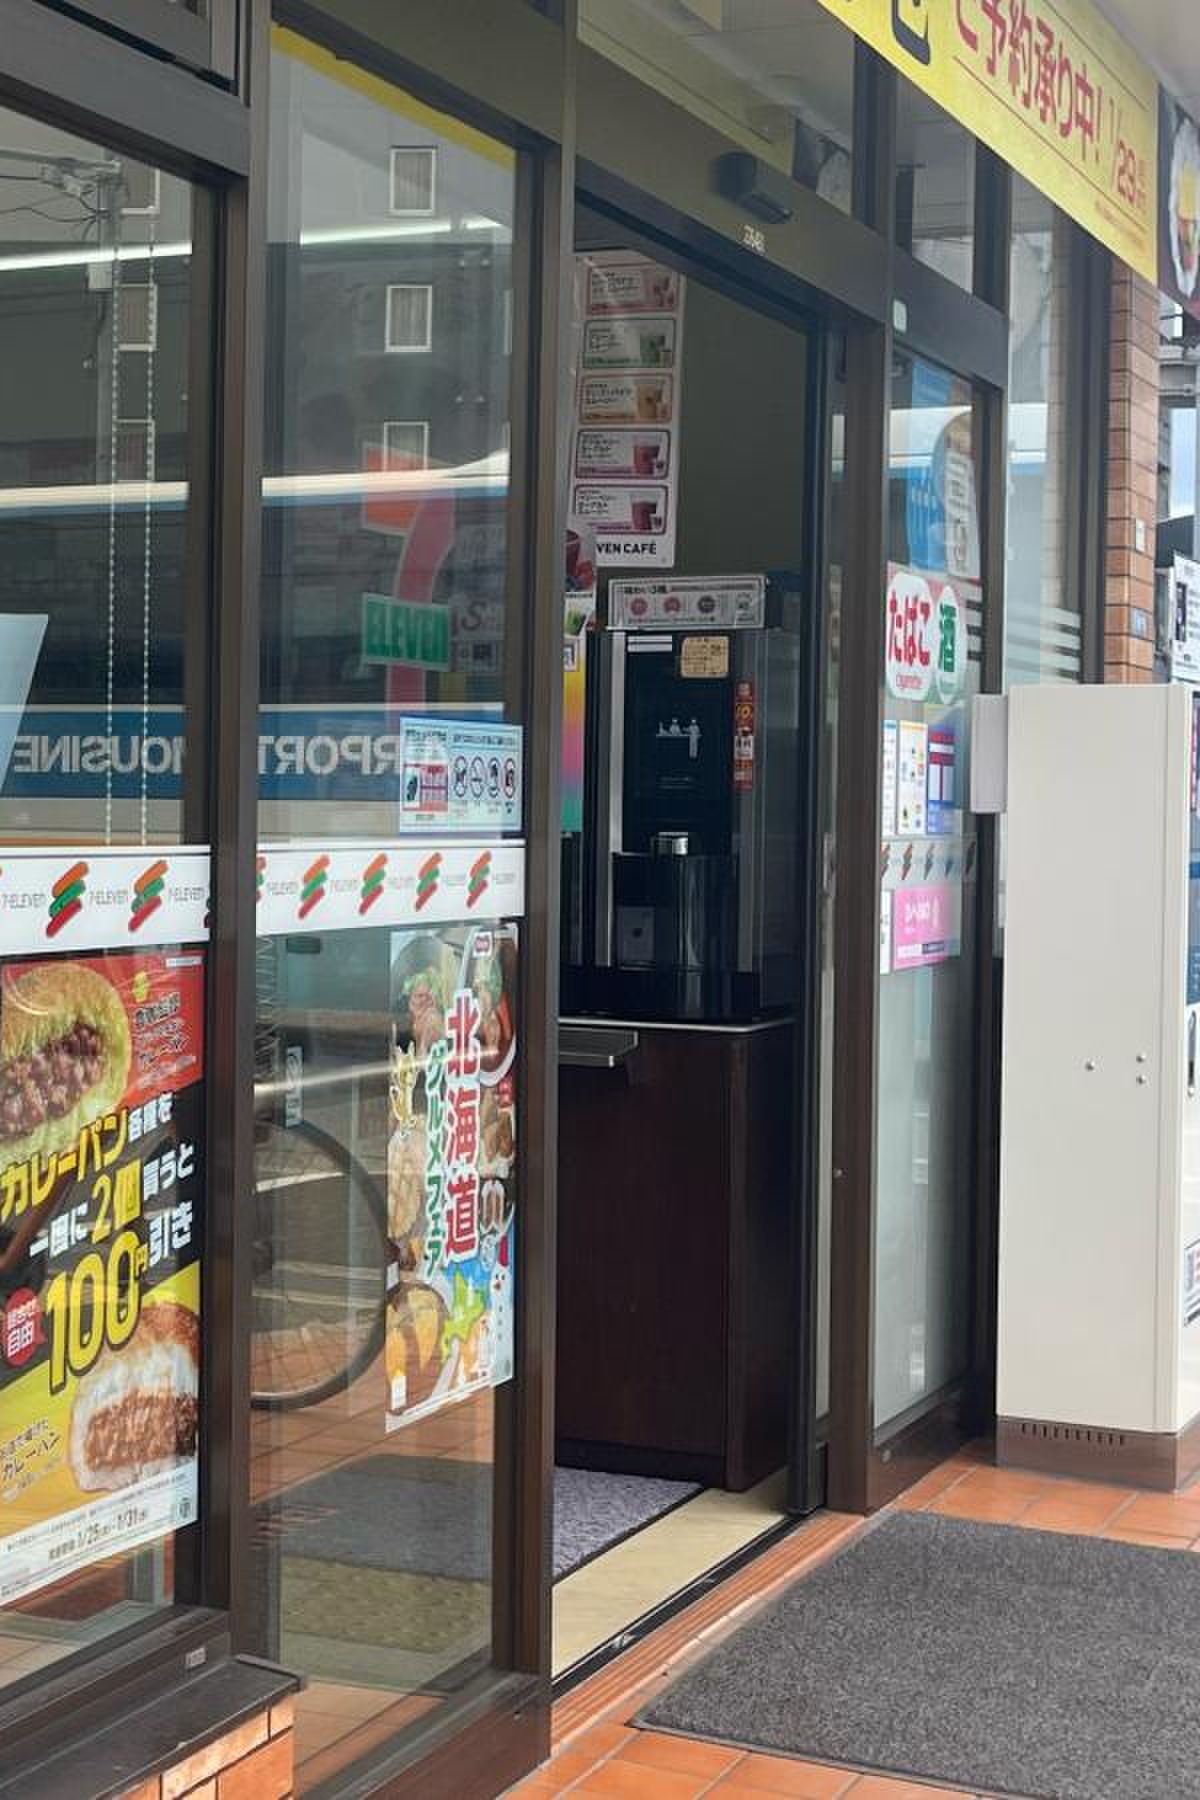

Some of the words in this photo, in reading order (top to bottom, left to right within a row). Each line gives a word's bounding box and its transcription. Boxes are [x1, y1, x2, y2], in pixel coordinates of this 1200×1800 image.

[889, 588, 930, 667] たばこ
[446, 991, 481, 1260] 北海道
